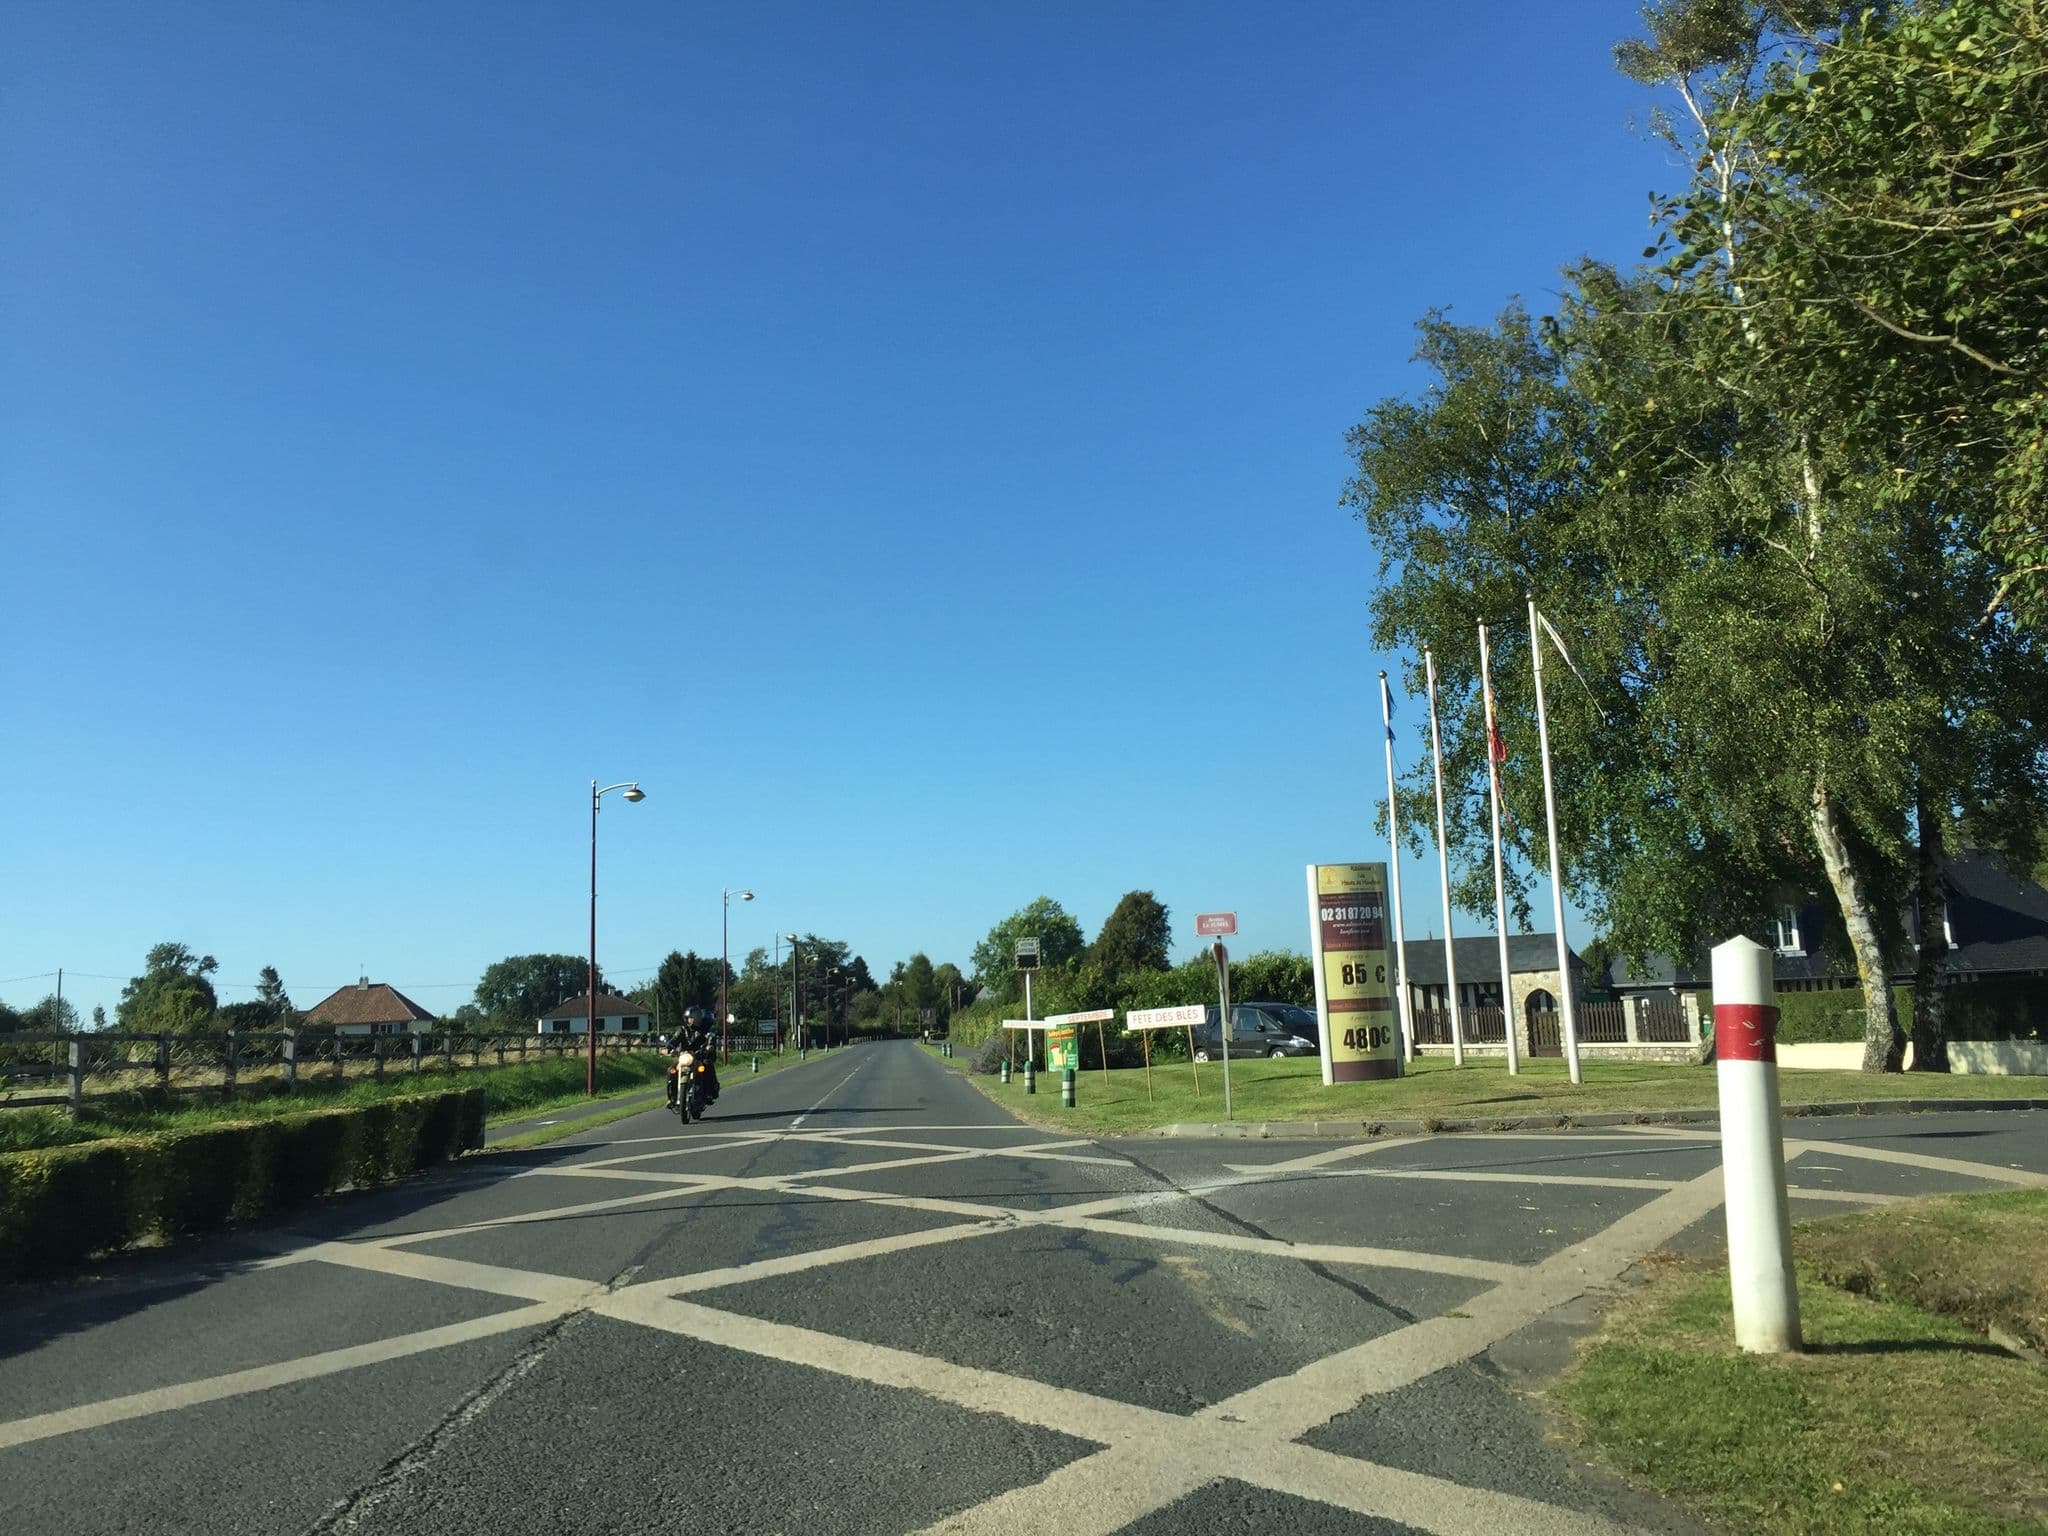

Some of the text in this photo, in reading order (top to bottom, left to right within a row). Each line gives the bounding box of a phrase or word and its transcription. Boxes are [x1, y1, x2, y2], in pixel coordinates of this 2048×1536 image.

[1321, 908, 1334, 921] 02
[1335, 907, 1347, 920] 31
[1348, 907, 1358, 919] 87
[1360, 906, 1371, 919] 20
[1342, 964, 1367, 985] 85
[1155, 1011, 1173, 1022] DES
[1176, 1008, 1199, 1021] BLES
